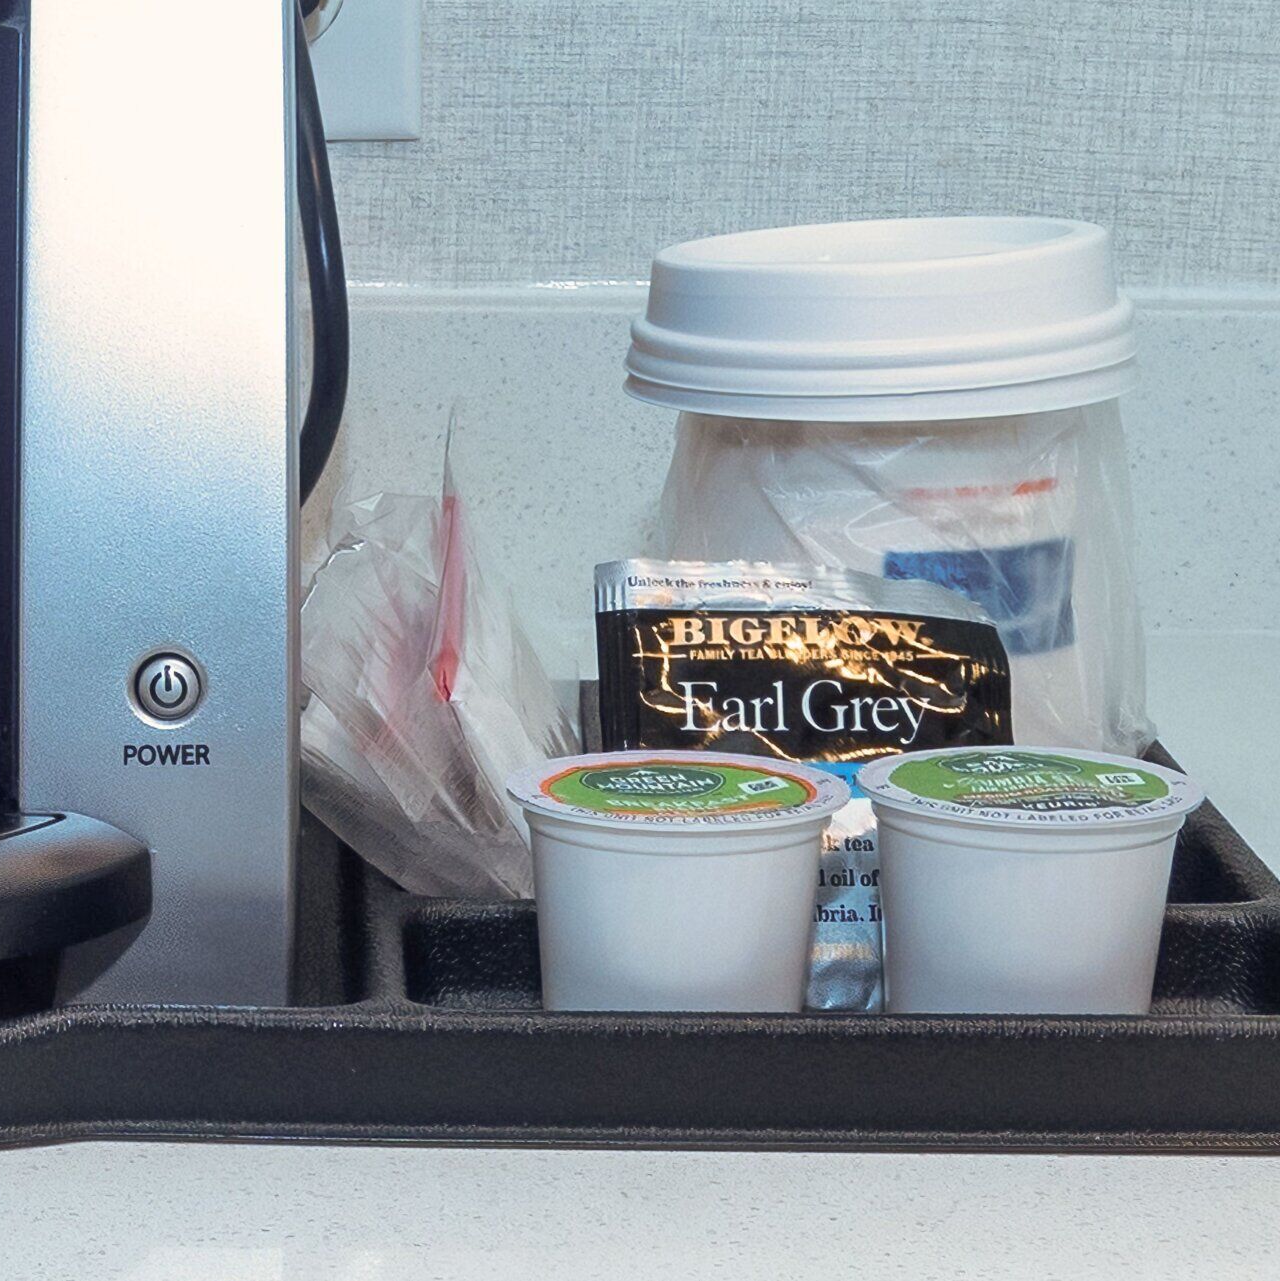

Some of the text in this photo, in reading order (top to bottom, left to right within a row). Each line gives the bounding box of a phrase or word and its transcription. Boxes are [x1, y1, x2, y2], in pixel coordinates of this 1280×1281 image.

[689, 648, 735, 661] FAMILY
[739, 649, 764, 660] TEA
[677, 680, 931, 744] Earl Grey
[123, 744, 210, 766] POWER
[845, 837, 874, 851] tea
[830, 869, 855, 887] oil
[860, 869, 880, 887] of
[814, 905, 864, 923] bria.
